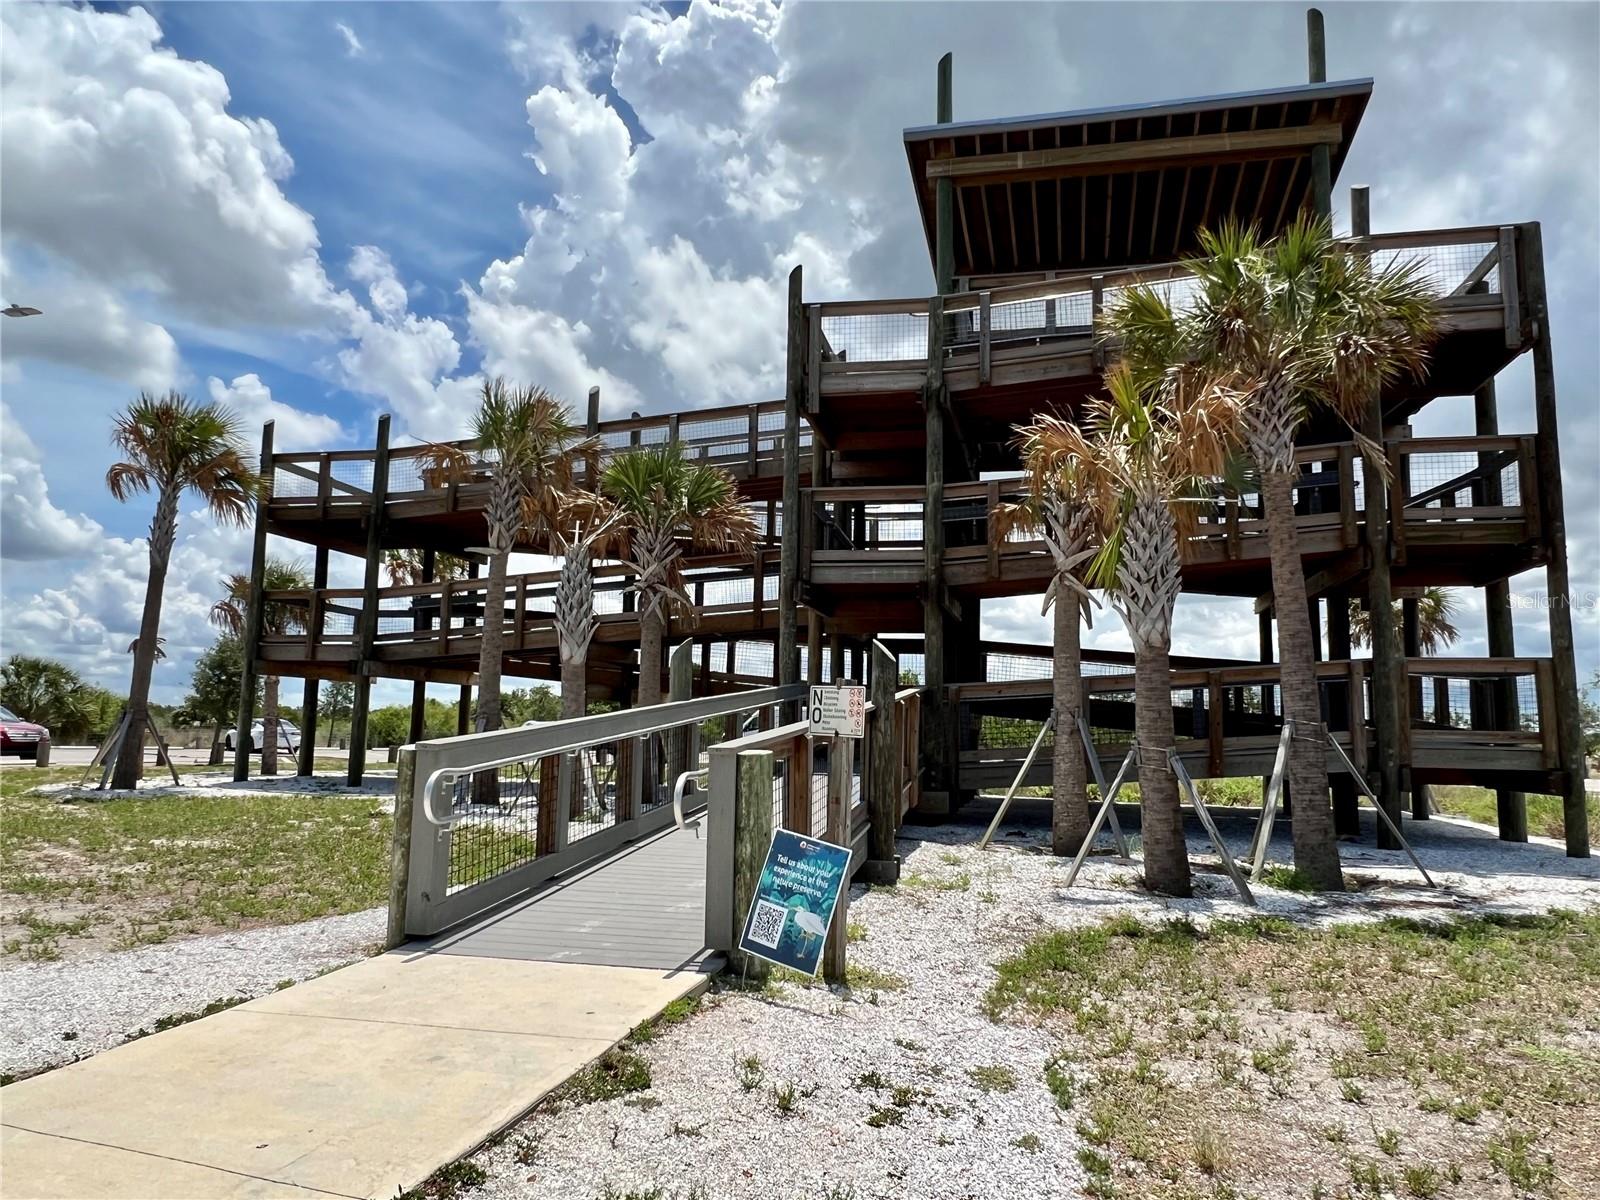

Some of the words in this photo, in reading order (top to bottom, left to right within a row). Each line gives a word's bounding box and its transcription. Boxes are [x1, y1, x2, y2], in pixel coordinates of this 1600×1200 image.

[773, 866, 807, 882] experience
[807, 876, 816, 884] at
[815, 877, 829, 889] this
[777, 854, 788, 865] Tell
[796, 861, 816, 873] about
[815, 868, 831, 879] your
[772, 876, 793, 888] nature
[792, 883, 822, 898] preserve.
